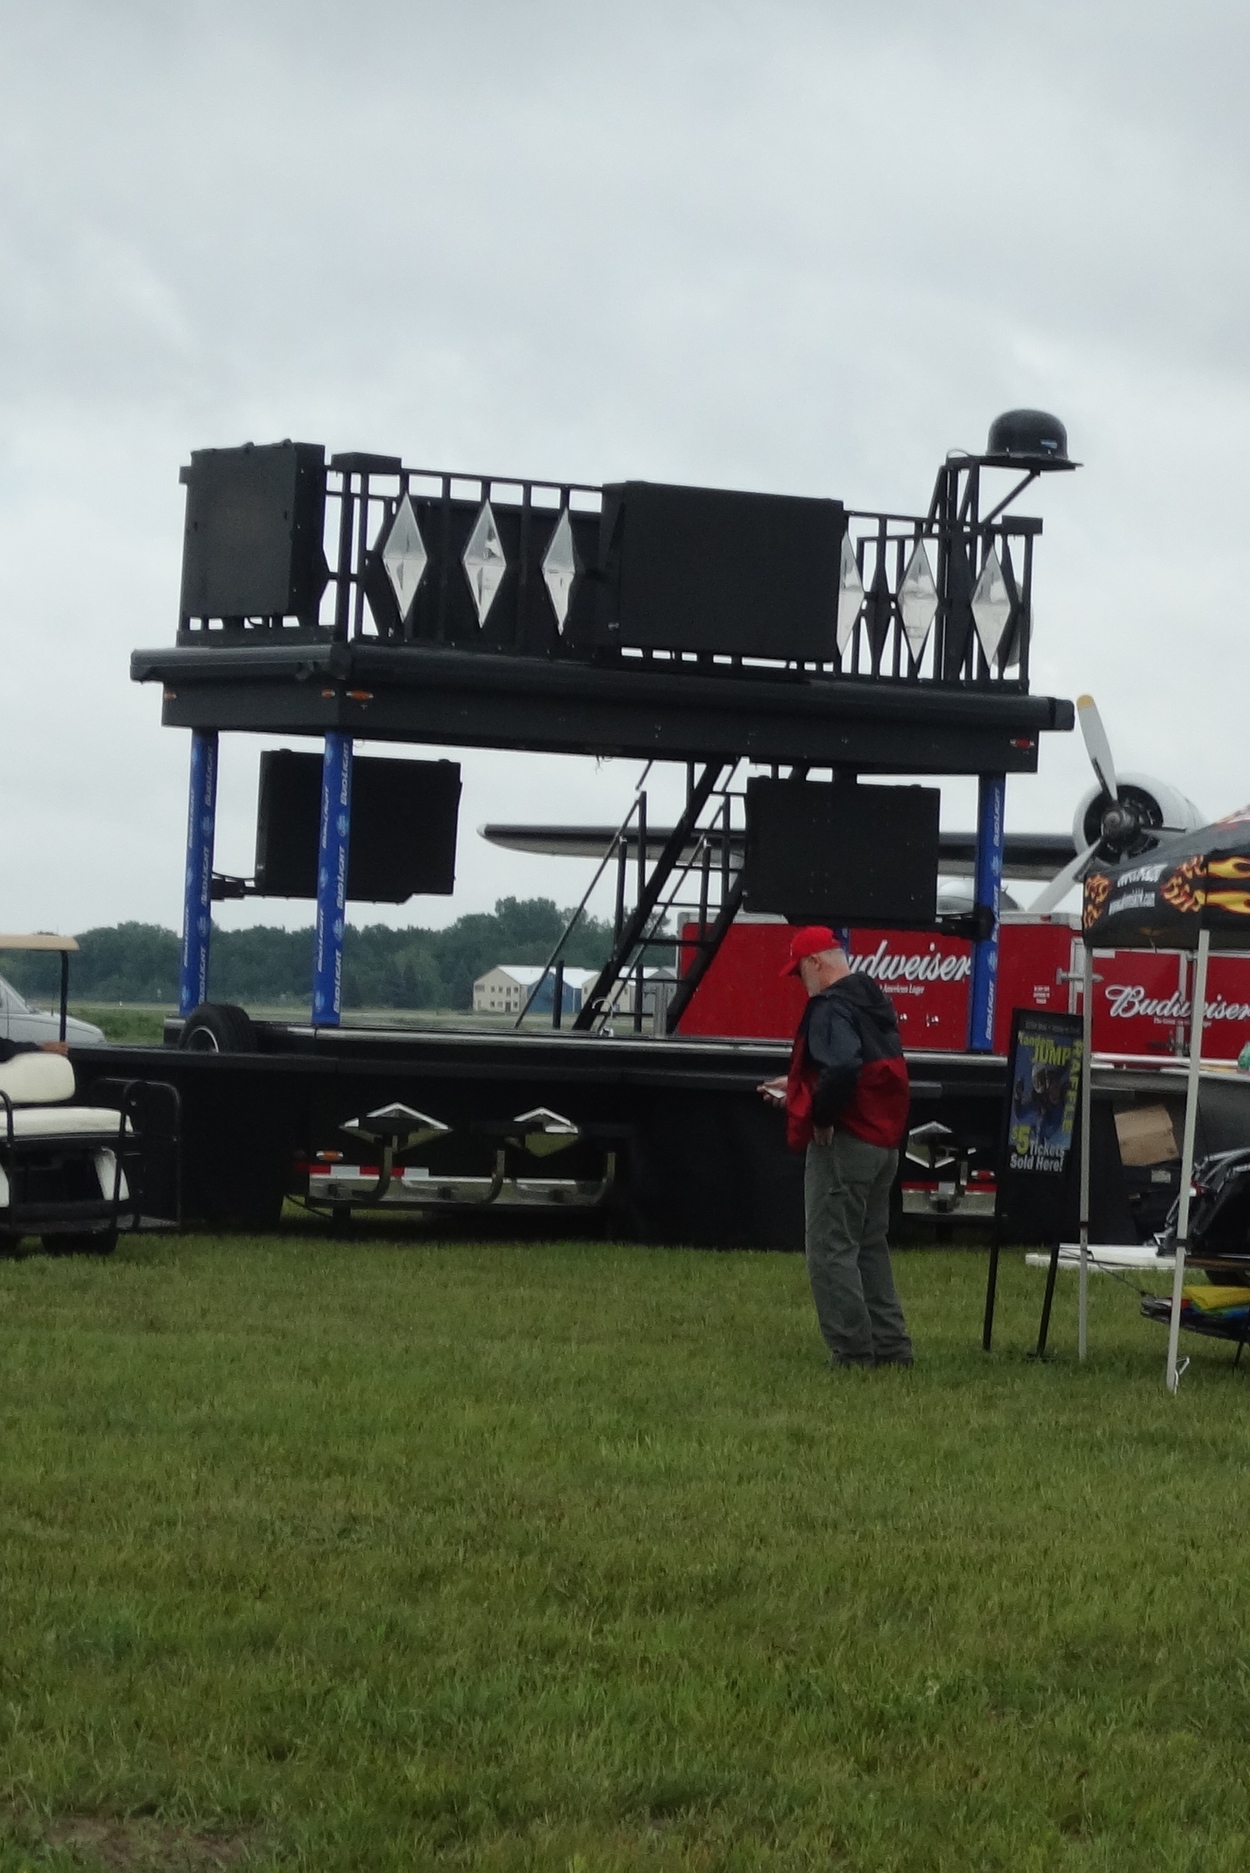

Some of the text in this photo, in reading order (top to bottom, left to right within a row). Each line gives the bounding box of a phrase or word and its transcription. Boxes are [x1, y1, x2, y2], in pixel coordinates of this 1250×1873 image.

[849, 939, 971, 981] udweiser
[1031, 1041, 1072, 1067] JUMP
[1009, 1152, 1064, 1173] Sold Here!
